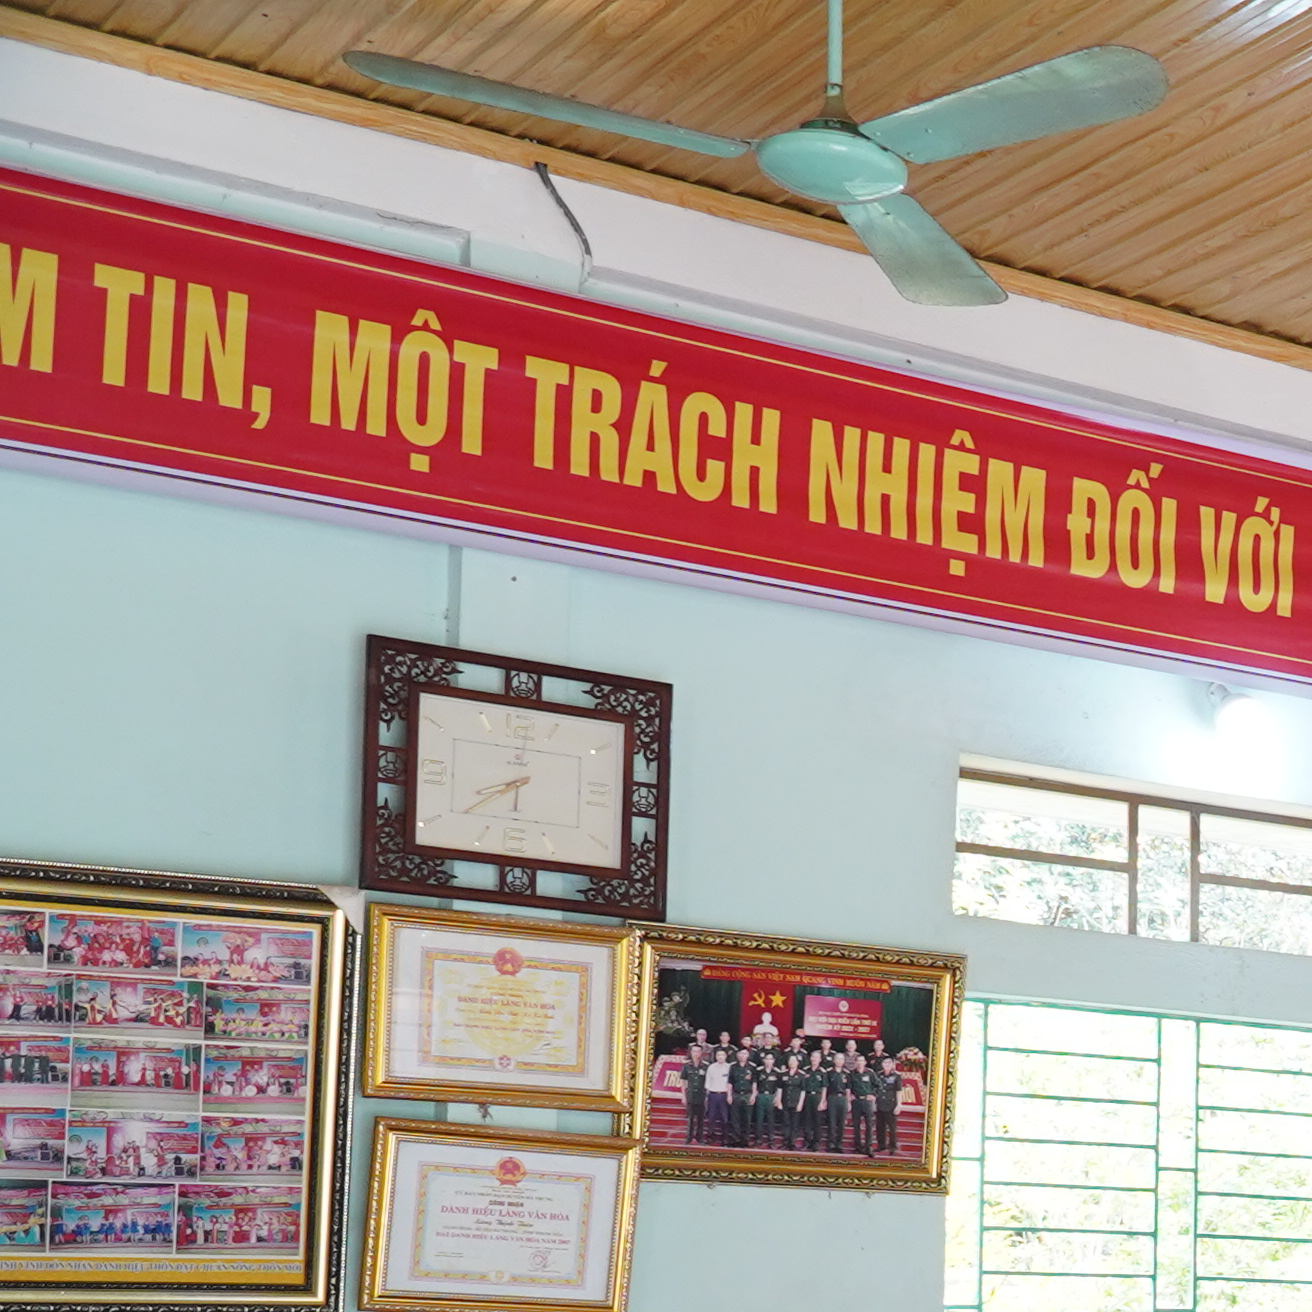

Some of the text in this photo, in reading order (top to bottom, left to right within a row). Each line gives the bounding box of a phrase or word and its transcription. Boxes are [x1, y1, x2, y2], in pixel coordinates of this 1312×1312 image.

[94, 264, 272, 430] TIN,
[311, 310, 499, 472] MỘT
[526, 361, 780, 514] TRÁCH
[808, 420, 1046, 577] NHIỆM
[1067, 463, 1176, 593] ĐỐI
[1200, 497, 1293, 617] VỚI
[506, 713, 535, 741] 12
[504, 827, 526, 853] 6
[711, 969, 731, 977] ĐẢNG
[732, 970, 750, 979] CỘNG
[768, 972, 784, 982] VIỆT
[802, 975, 826, 984] QUANG
[827, 976, 843, 985] VINH
[845, 977, 865, 987] MUÔN
[866, 979, 882, 989] NĂM
[472, 1206, 498, 1217] HIỆU
[498, 1208, 525, 1218] LÀNG
[528, 1210, 547, 1219] VĂN
[550, 1211, 570, 1221] HÓA
